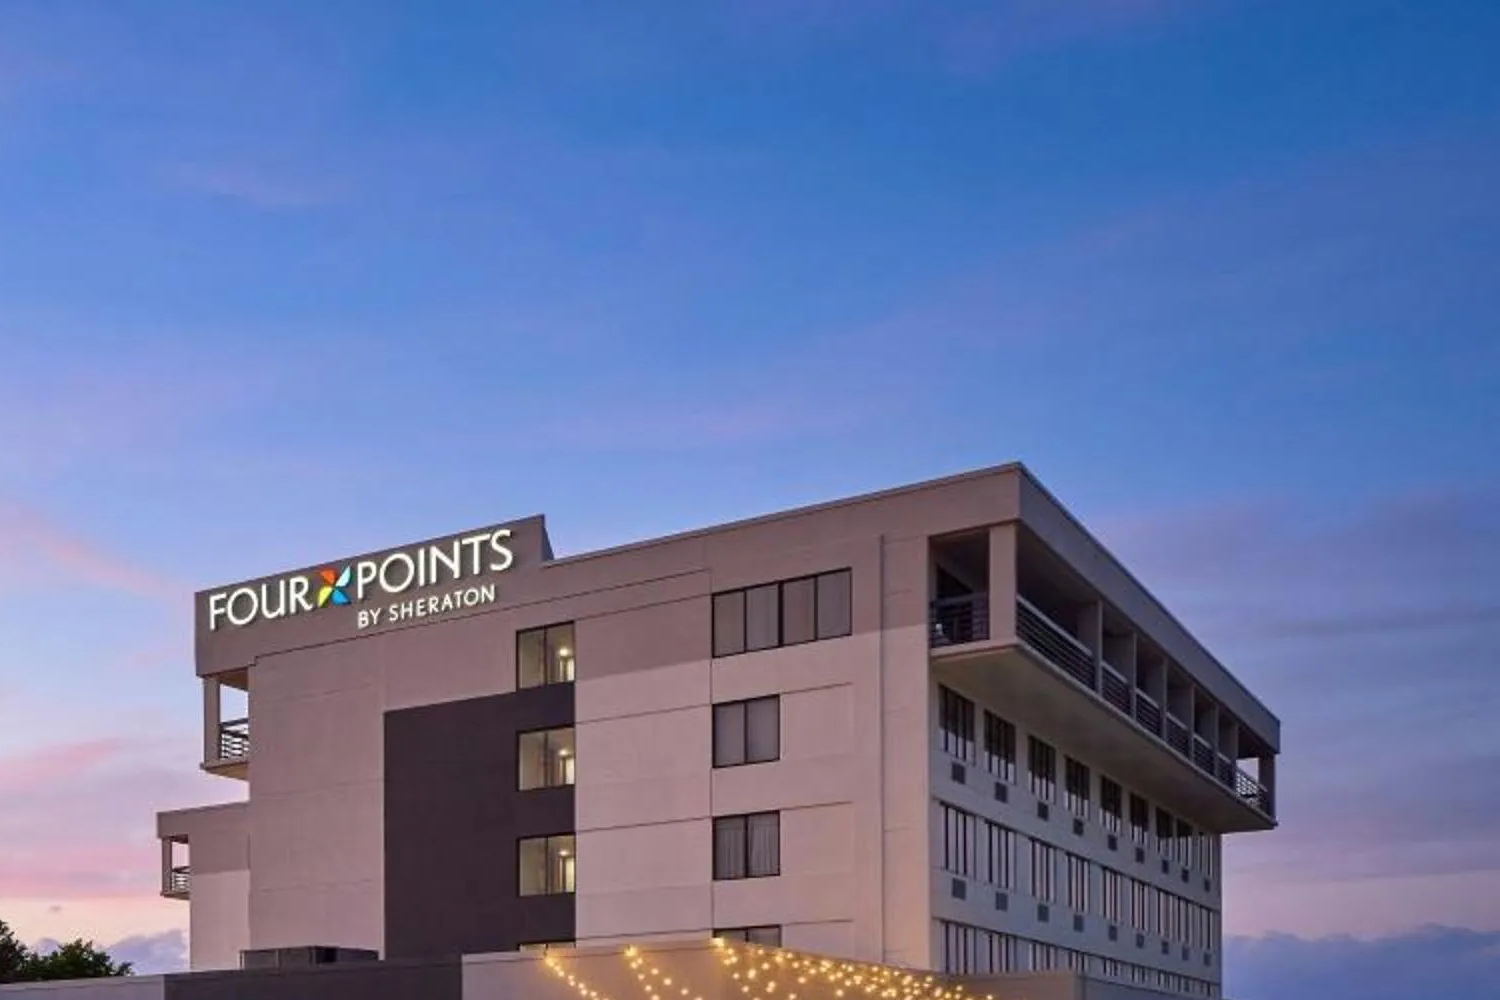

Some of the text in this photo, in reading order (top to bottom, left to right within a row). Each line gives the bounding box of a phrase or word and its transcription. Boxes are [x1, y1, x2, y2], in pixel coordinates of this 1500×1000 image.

[209, 529, 514, 631] FOUR POINTS
[358, 584, 496, 629] BY SHERATON
